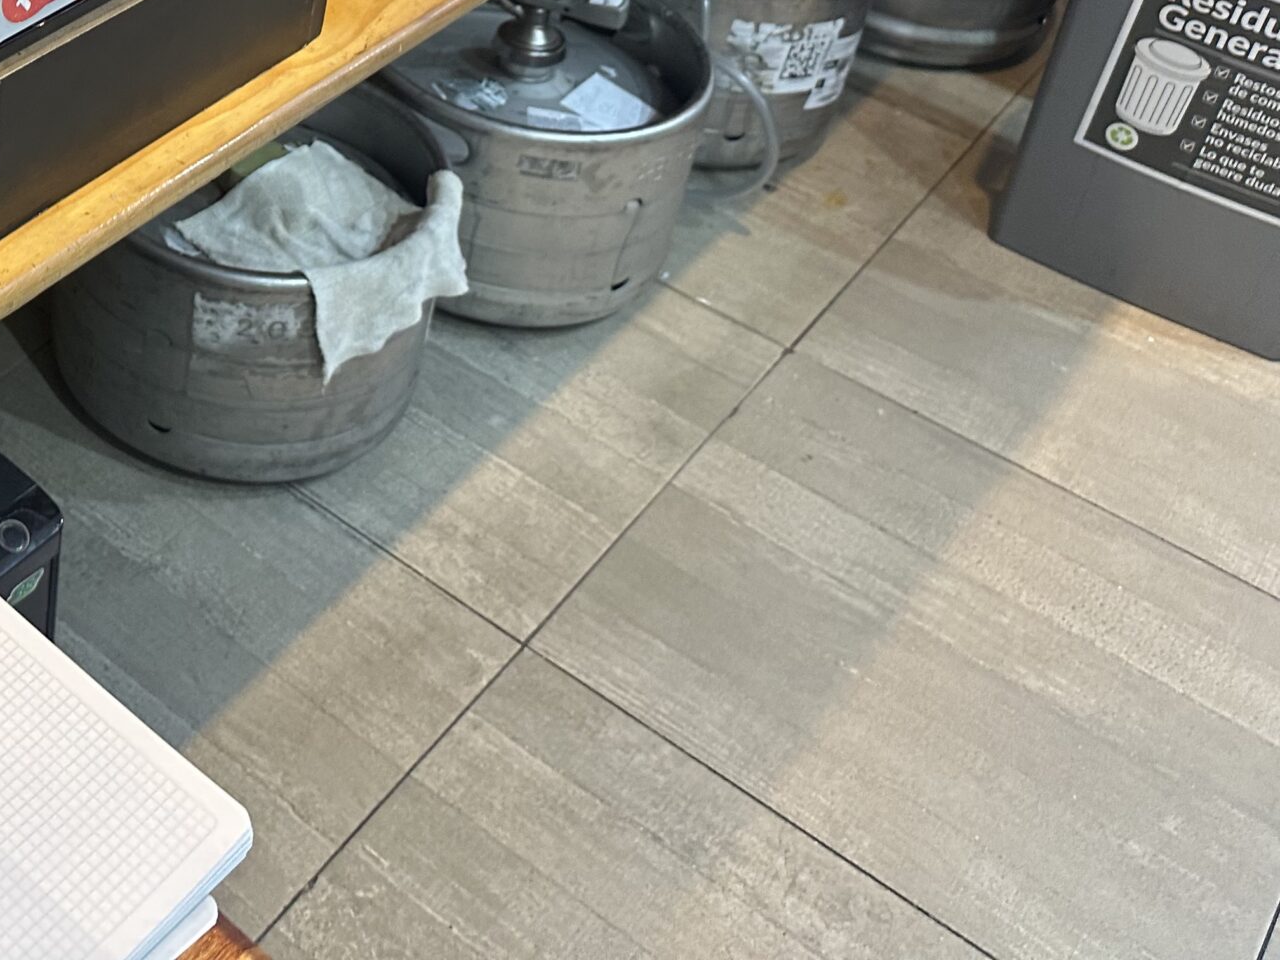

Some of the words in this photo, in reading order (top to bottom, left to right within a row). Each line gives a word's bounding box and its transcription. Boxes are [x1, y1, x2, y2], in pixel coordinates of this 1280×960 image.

[1228, 85, 1248, 99] de
[1205, 135, 1224, 149] no
[1210, 122, 1268, 153] Envases
[1192, 158, 1243, 183] genere
[1199, 145, 1217, 161] Lo
[1219, 155, 1247, 172] que
[1249, 164, 1265, 179] te
